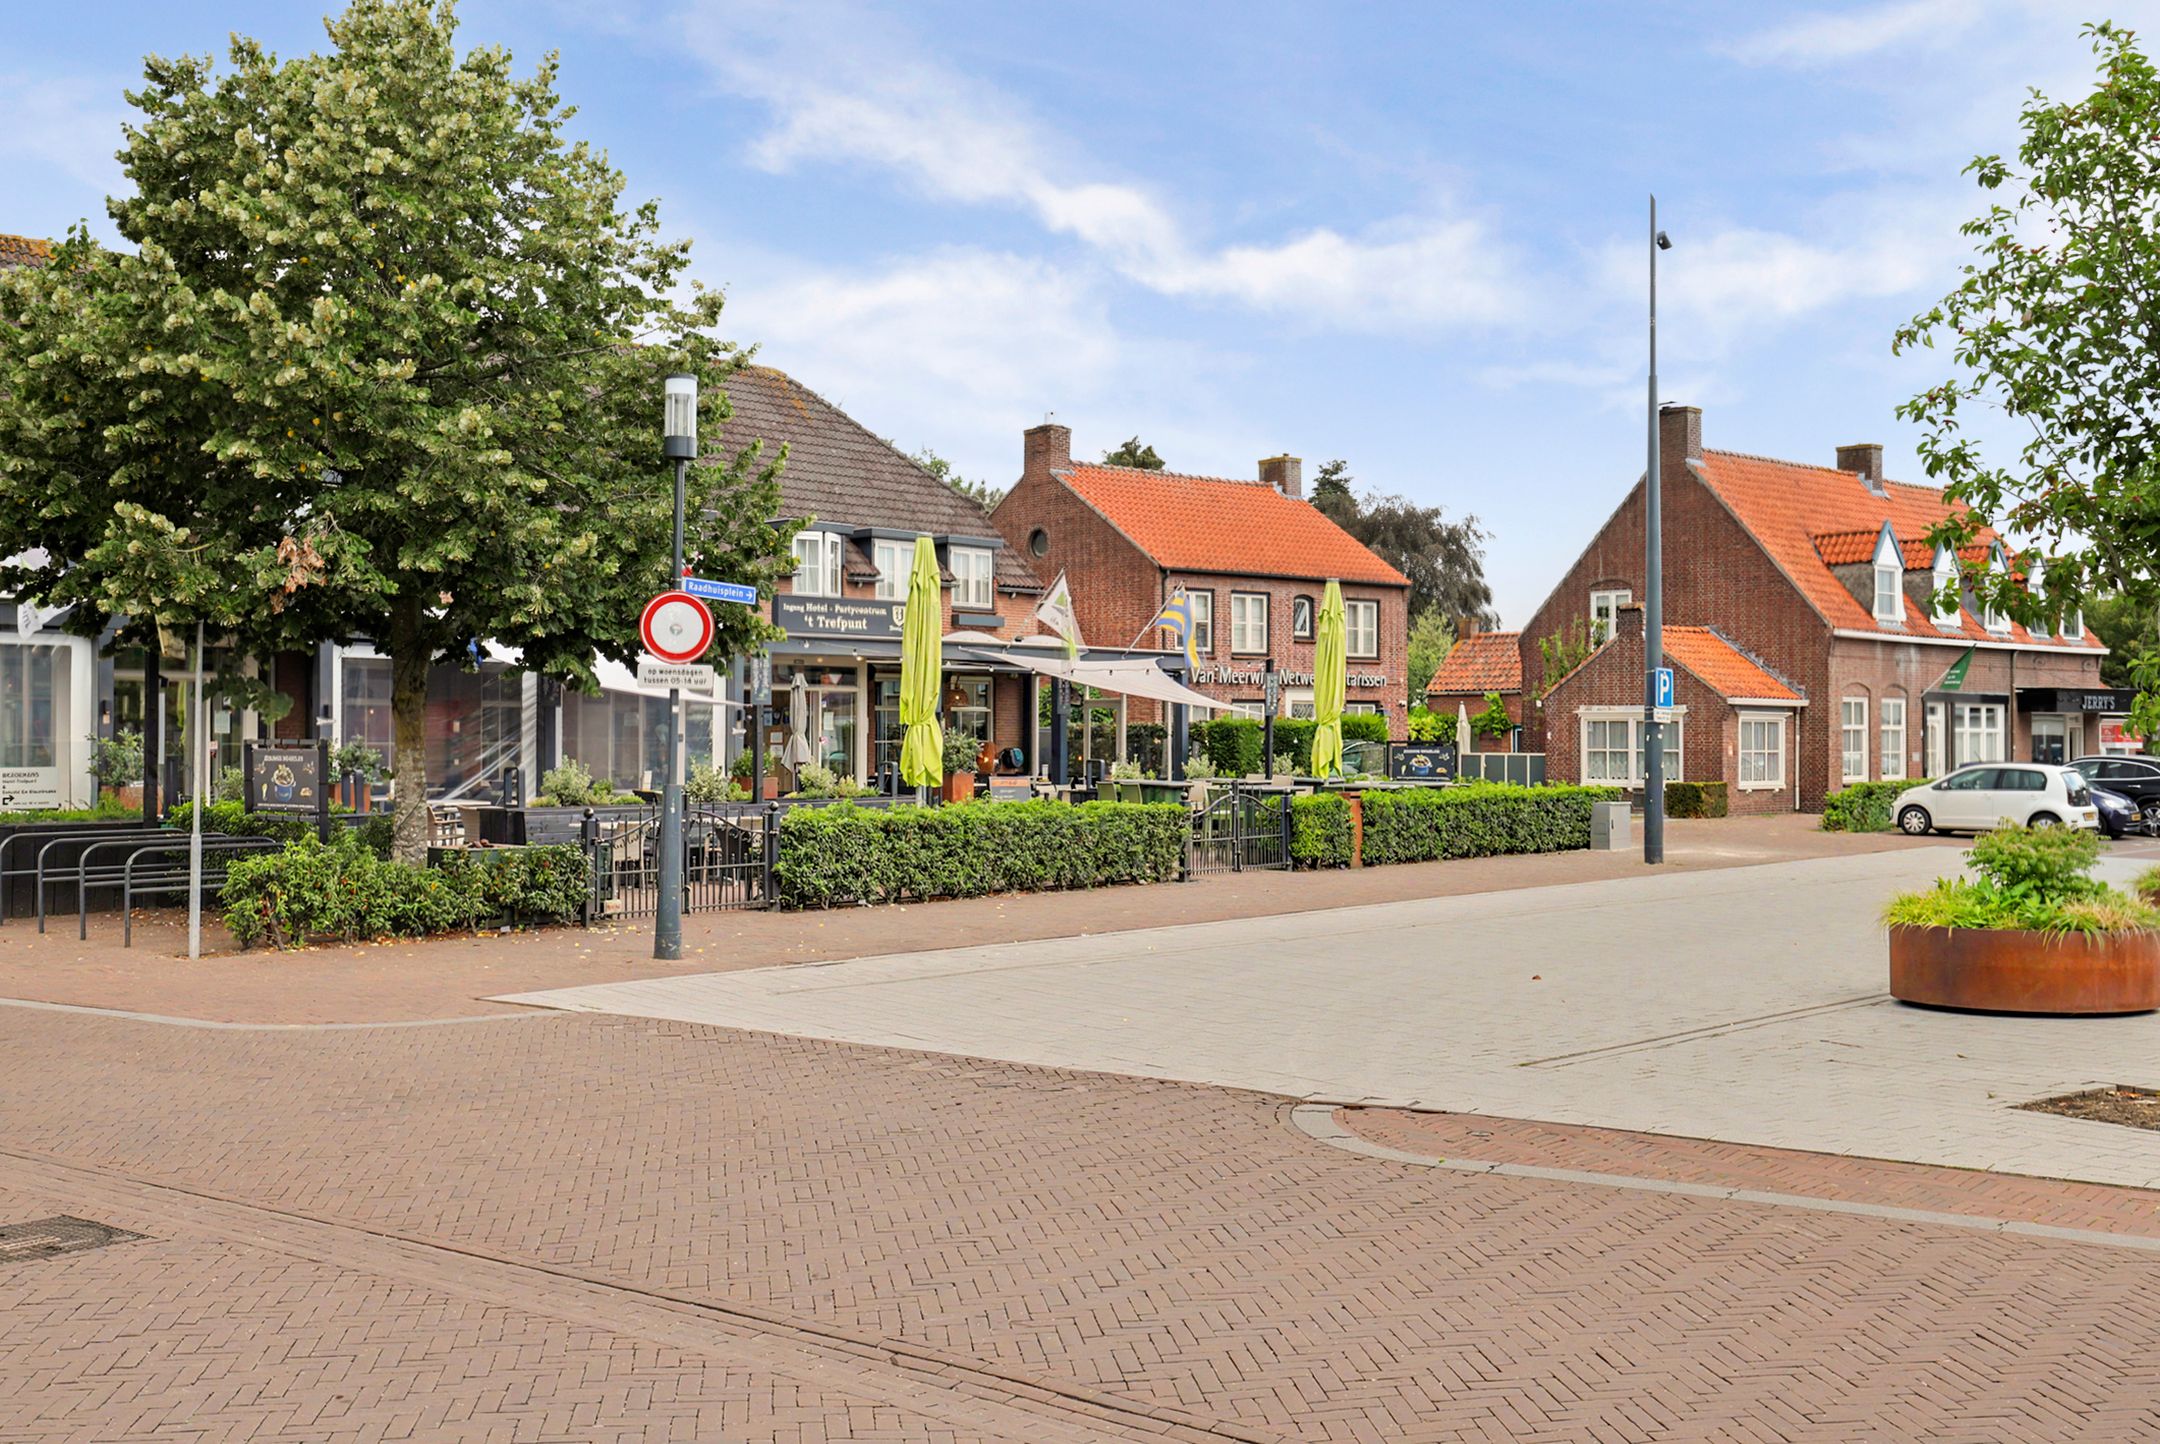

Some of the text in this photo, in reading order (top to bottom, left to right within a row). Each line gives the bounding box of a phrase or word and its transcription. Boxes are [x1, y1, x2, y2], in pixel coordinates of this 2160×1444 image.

[688, 581, 744, 598] Raadhuisplein
[806, 602, 828, 612] Hotel
[835, 604, 887, 616] Partycentrum
[817, 615, 868, 632] Trefpunt
[644, 676, 669, 684] tussen
[648, 668, 703, 677] op woensdagen
[1190, 667, 1214, 684] Van
[1278, 669, 1314, 686] Netwe
[1346, 672, 1387, 688] tarissen
[1660, 671, 1670, 703] P
[2082, 696, 2115, 710] JERRY'S
